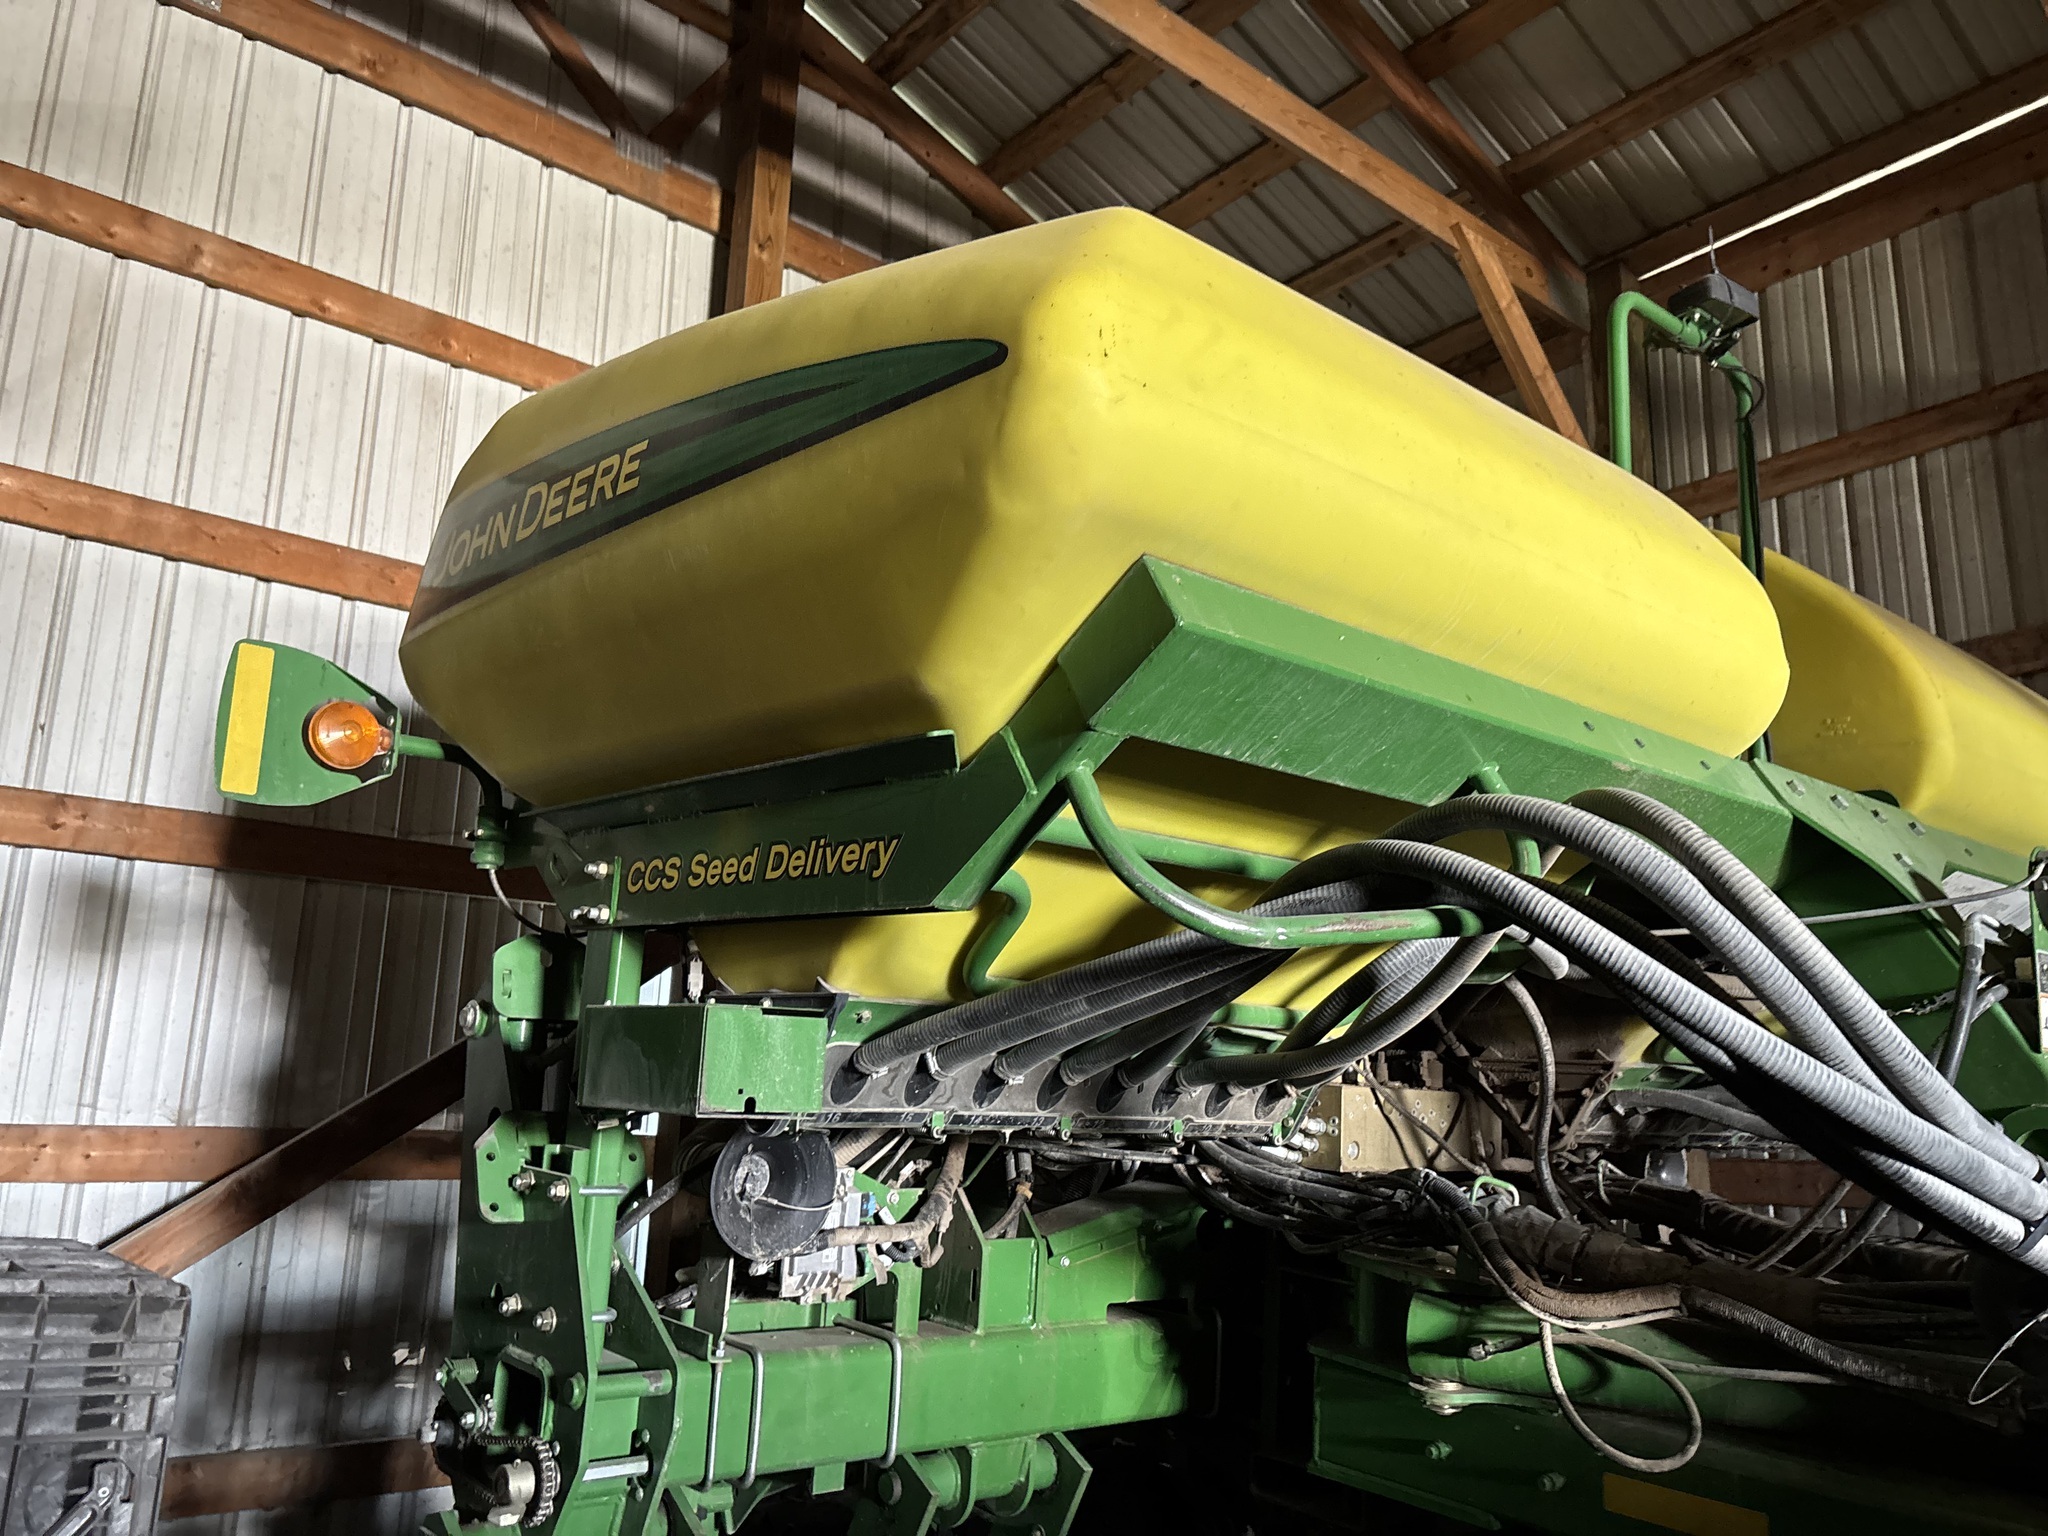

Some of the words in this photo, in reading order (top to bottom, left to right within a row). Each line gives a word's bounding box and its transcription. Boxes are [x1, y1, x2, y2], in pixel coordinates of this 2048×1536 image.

[432, 503, 517, 587] JOHN
[515, 439, 649, 542] DEERE
[626, 854, 682, 894] CCS
[687, 846, 760, 888] Seed
[764, 837, 900, 879] Delivery
[825, 1112, 842, 1123] 16
[899, 1112, 915, 1123] 15
[969, 1115, 983, 1125] 14
[1031, 1116, 1046, 1127] 13
